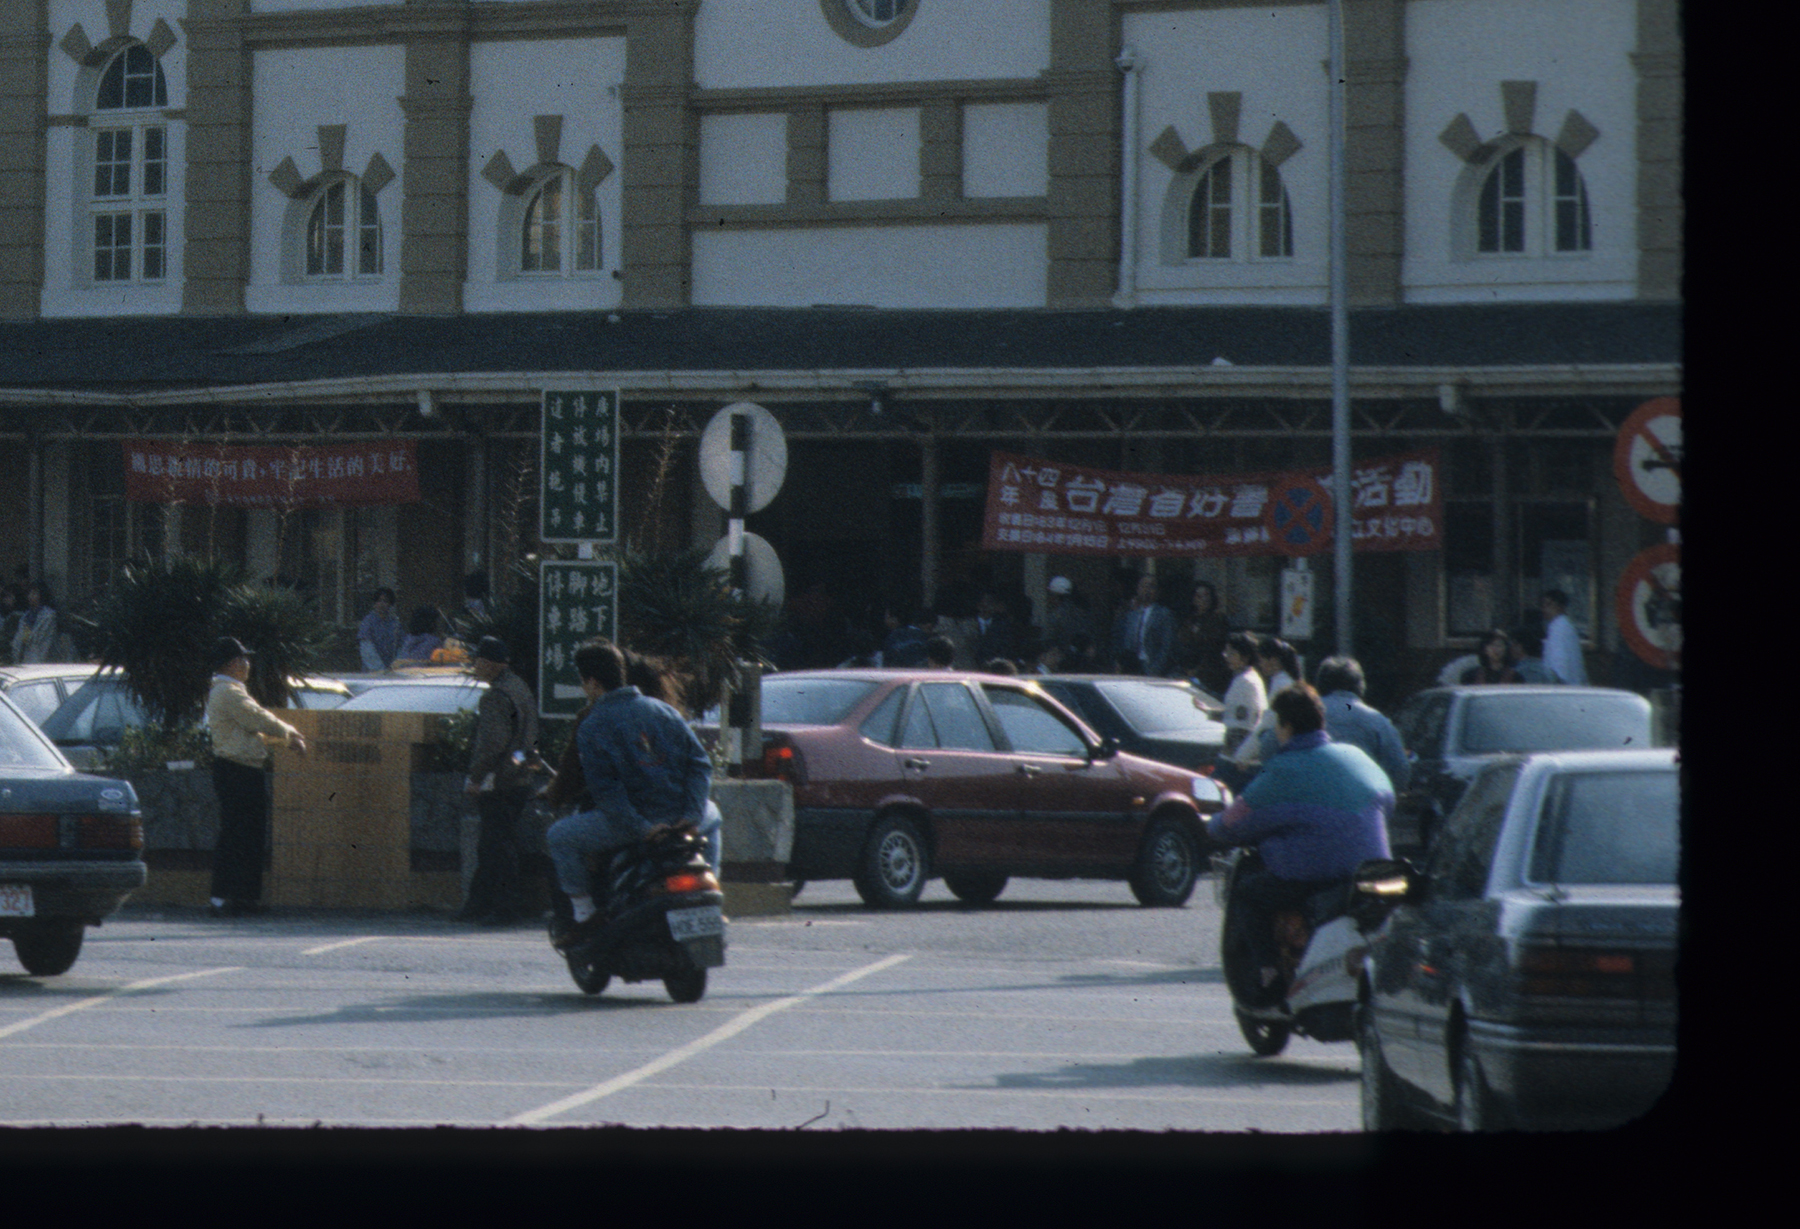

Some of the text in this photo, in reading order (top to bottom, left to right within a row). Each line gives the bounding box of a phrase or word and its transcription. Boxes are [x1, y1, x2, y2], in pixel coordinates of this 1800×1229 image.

[1001, 462, 1061, 487] 八十四
[545, 570, 565, 672] 停車場
